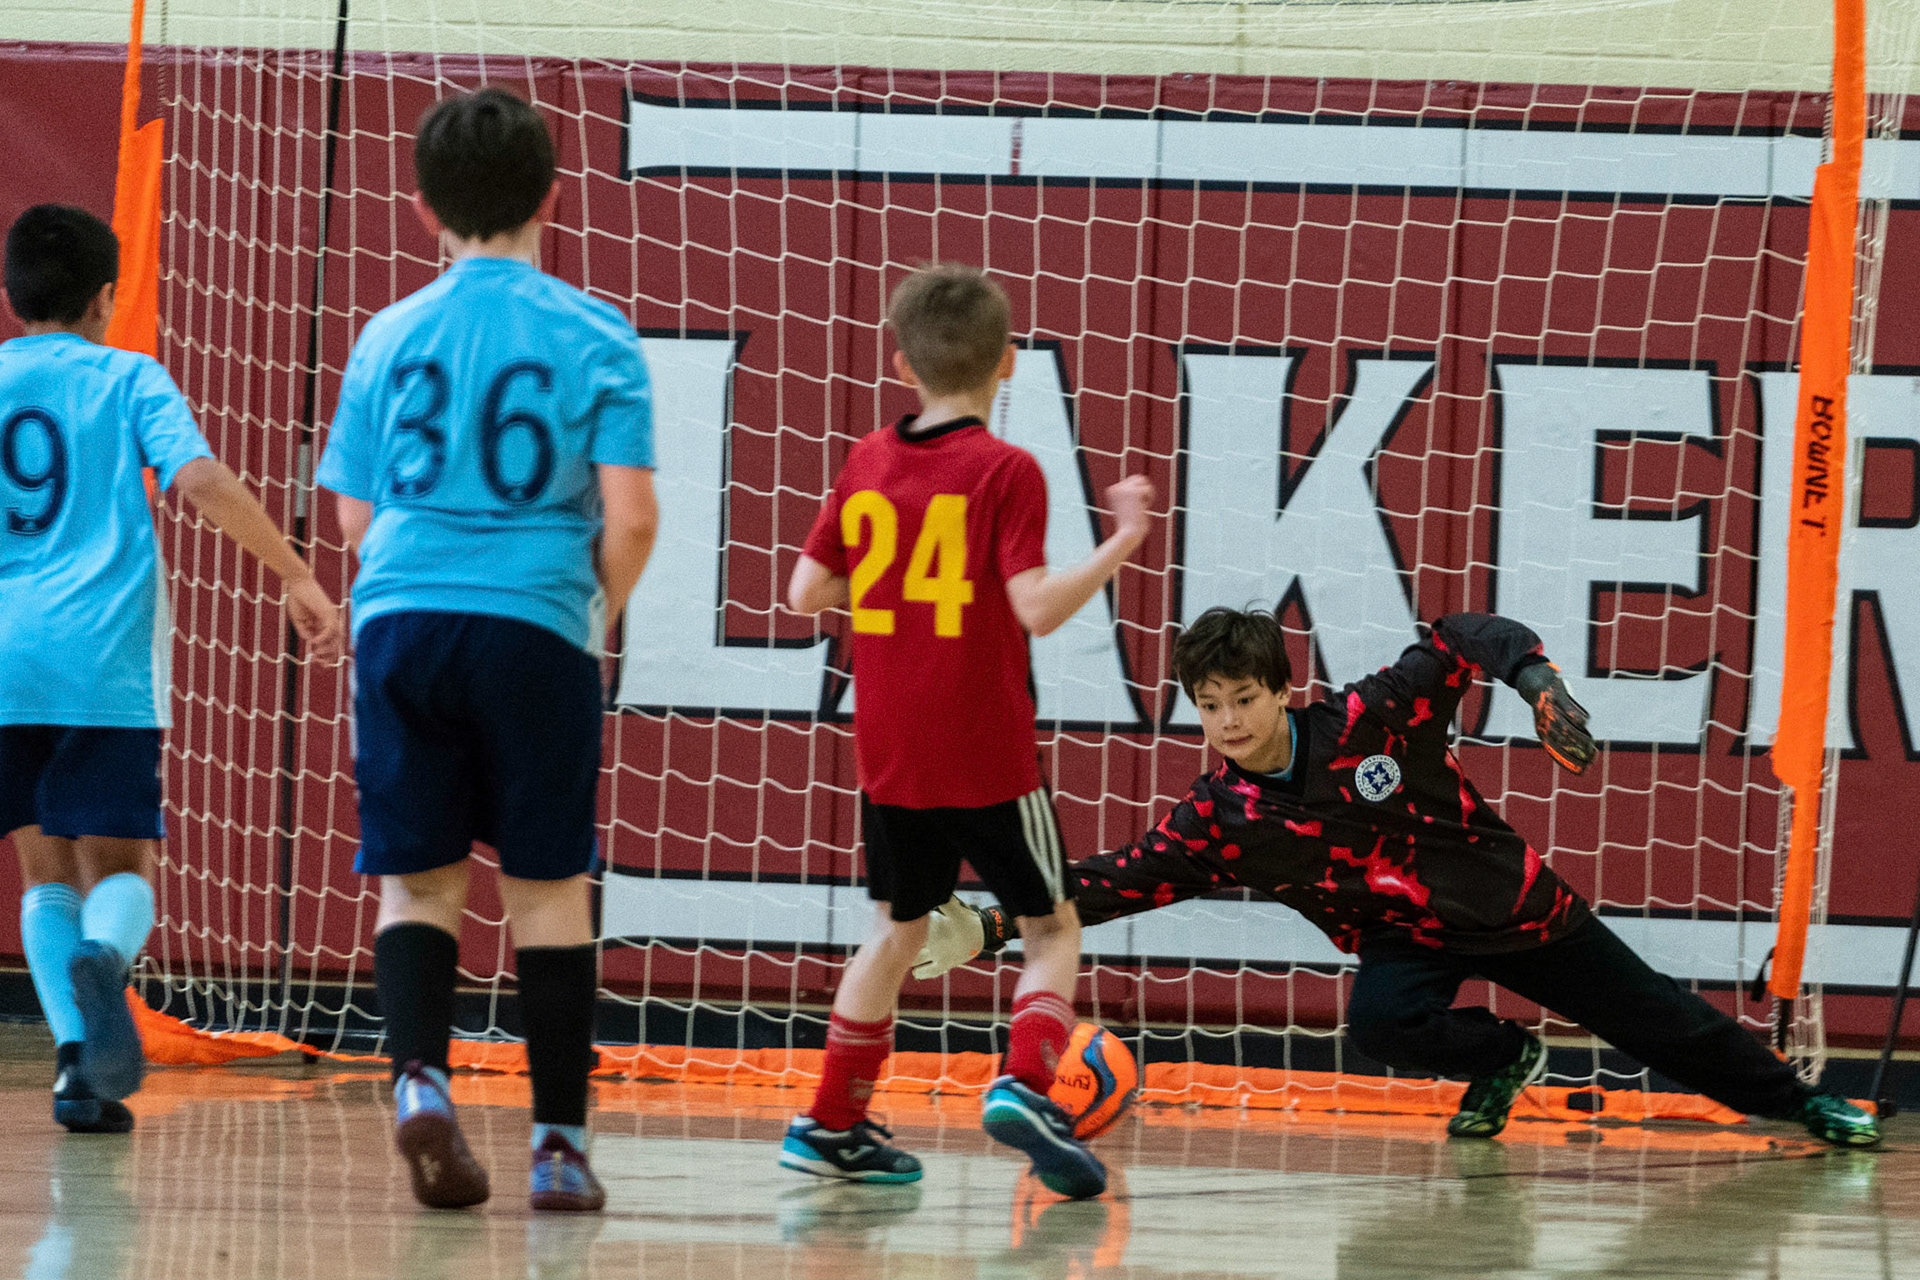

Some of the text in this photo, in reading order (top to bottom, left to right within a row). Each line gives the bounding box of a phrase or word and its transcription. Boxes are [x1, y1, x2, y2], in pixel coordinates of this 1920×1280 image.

[2, 406, 68, 535] 9
[392, 358, 557, 502] 36
[840, 489, 974, 638] 24
